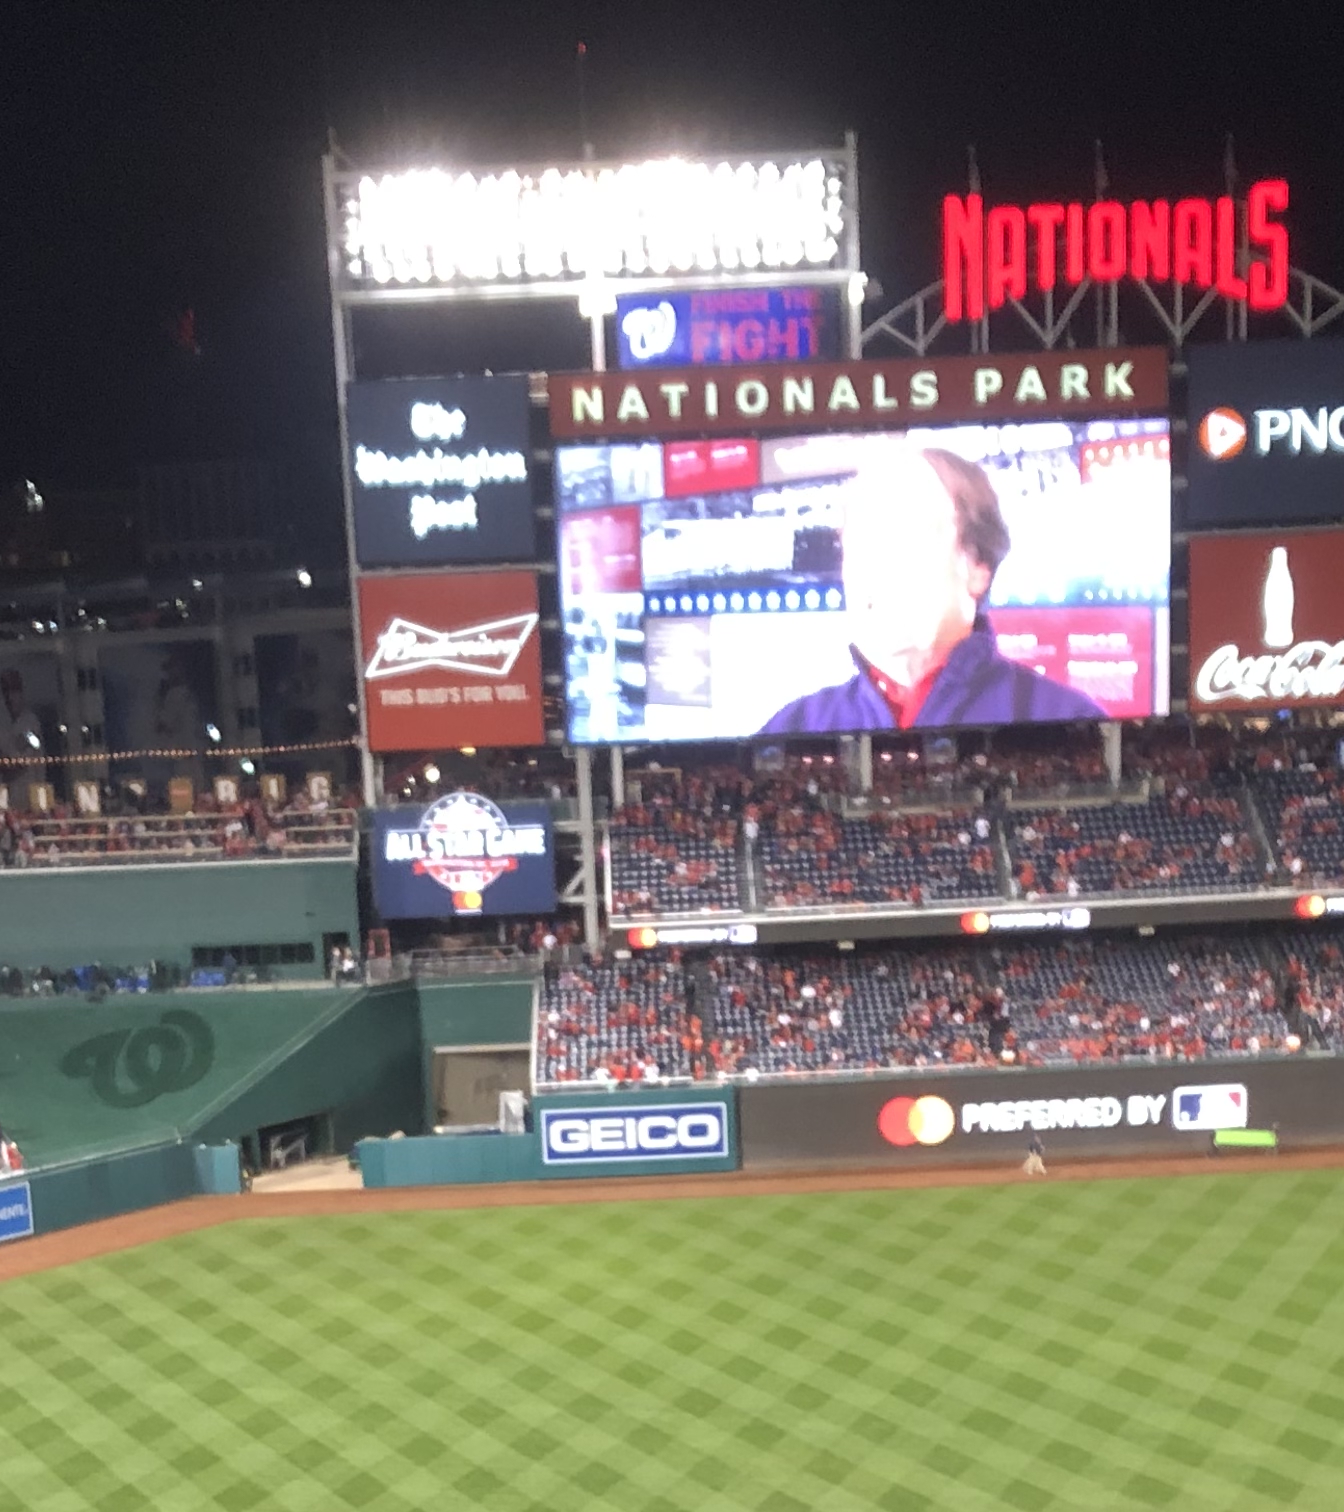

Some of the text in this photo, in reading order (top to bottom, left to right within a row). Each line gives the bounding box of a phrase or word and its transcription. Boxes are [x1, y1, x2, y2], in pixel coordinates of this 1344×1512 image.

[942, 178, 1290, 322] NATIONALS
[690, 317, 823, 364] FIGHT
[571, 361, 1138, 424] NATIONALS PARK
[548, 1113, 721, 1153] GEICO
[962, 1094, 1167, 1133] PREFERRED BY
